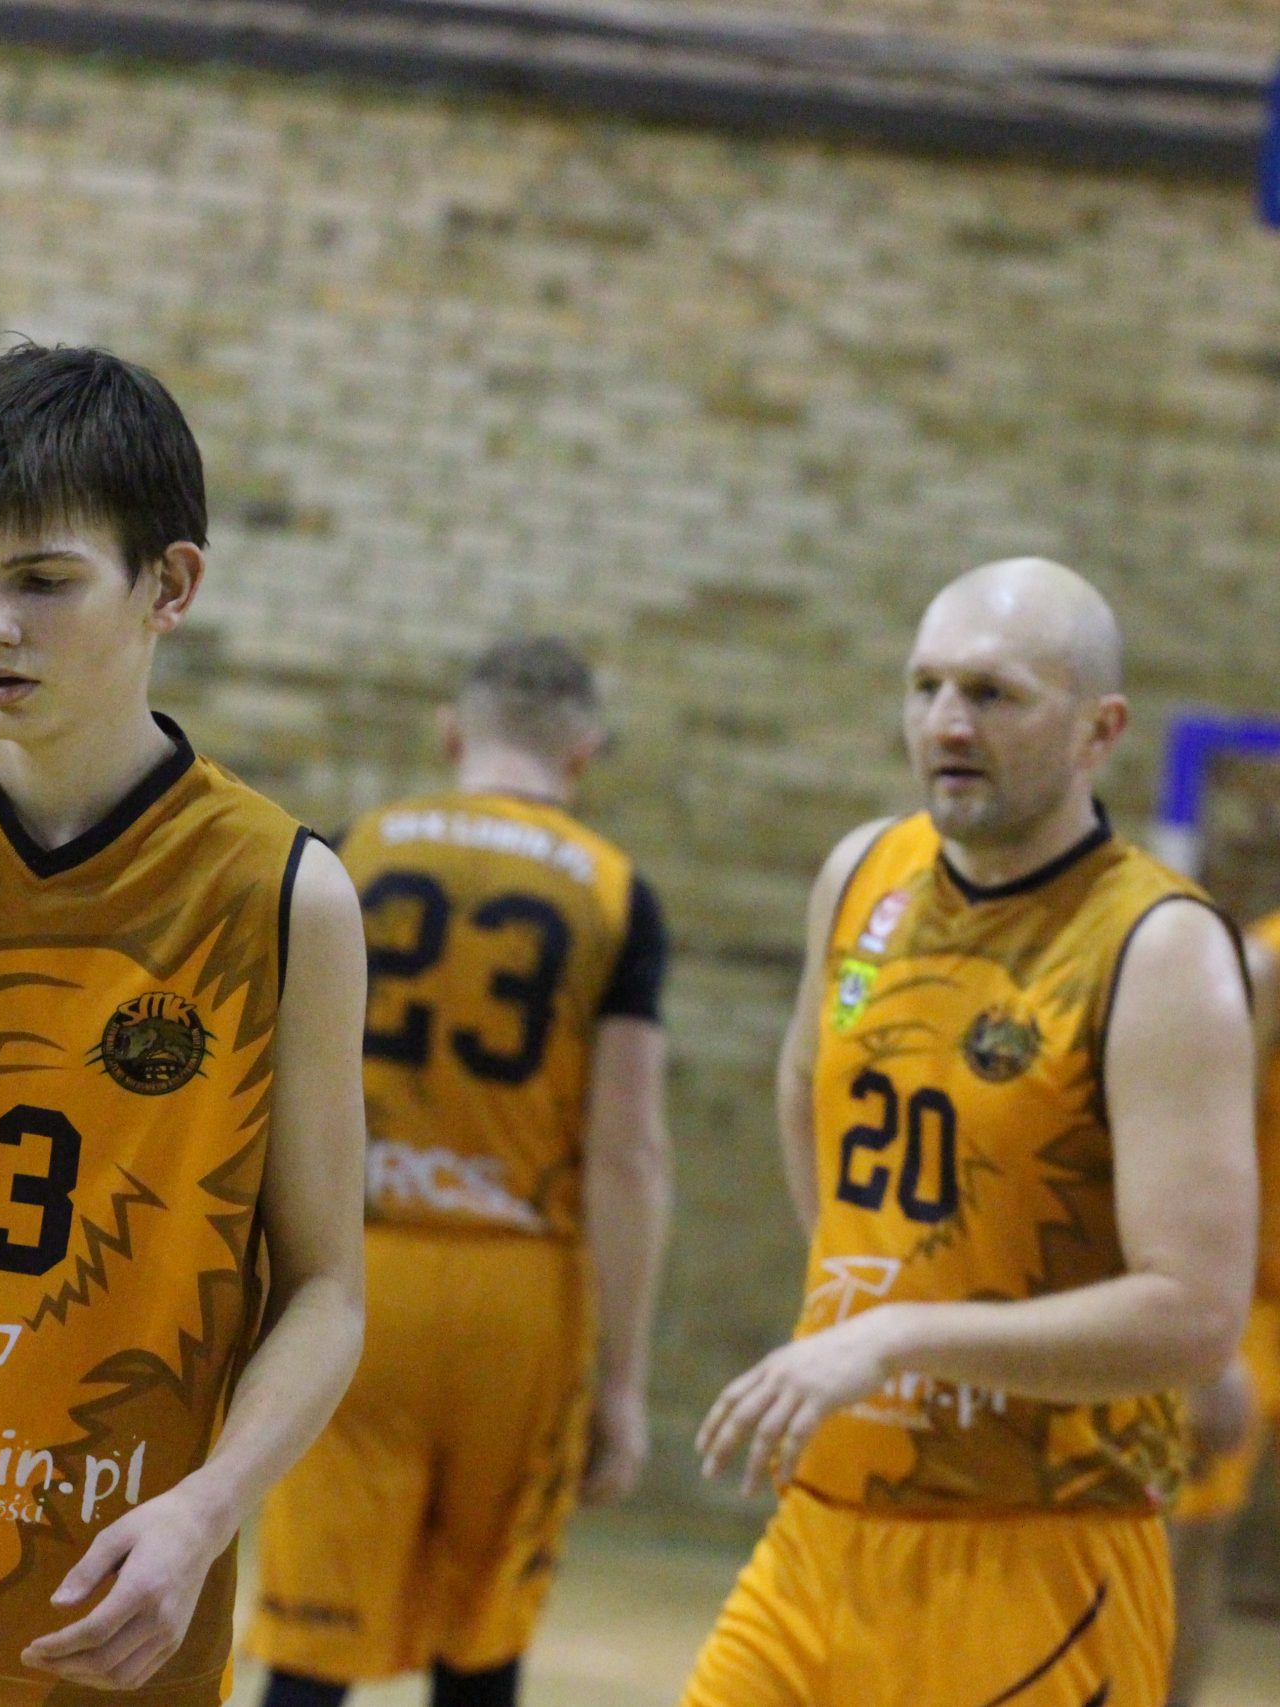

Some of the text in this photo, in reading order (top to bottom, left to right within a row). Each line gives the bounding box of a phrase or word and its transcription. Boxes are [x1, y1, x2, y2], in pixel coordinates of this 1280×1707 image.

[117, 991, 198, 1029] SMK
[363, 870, 573, 1084] 23
[836, 1070, 957, 1223] 20
